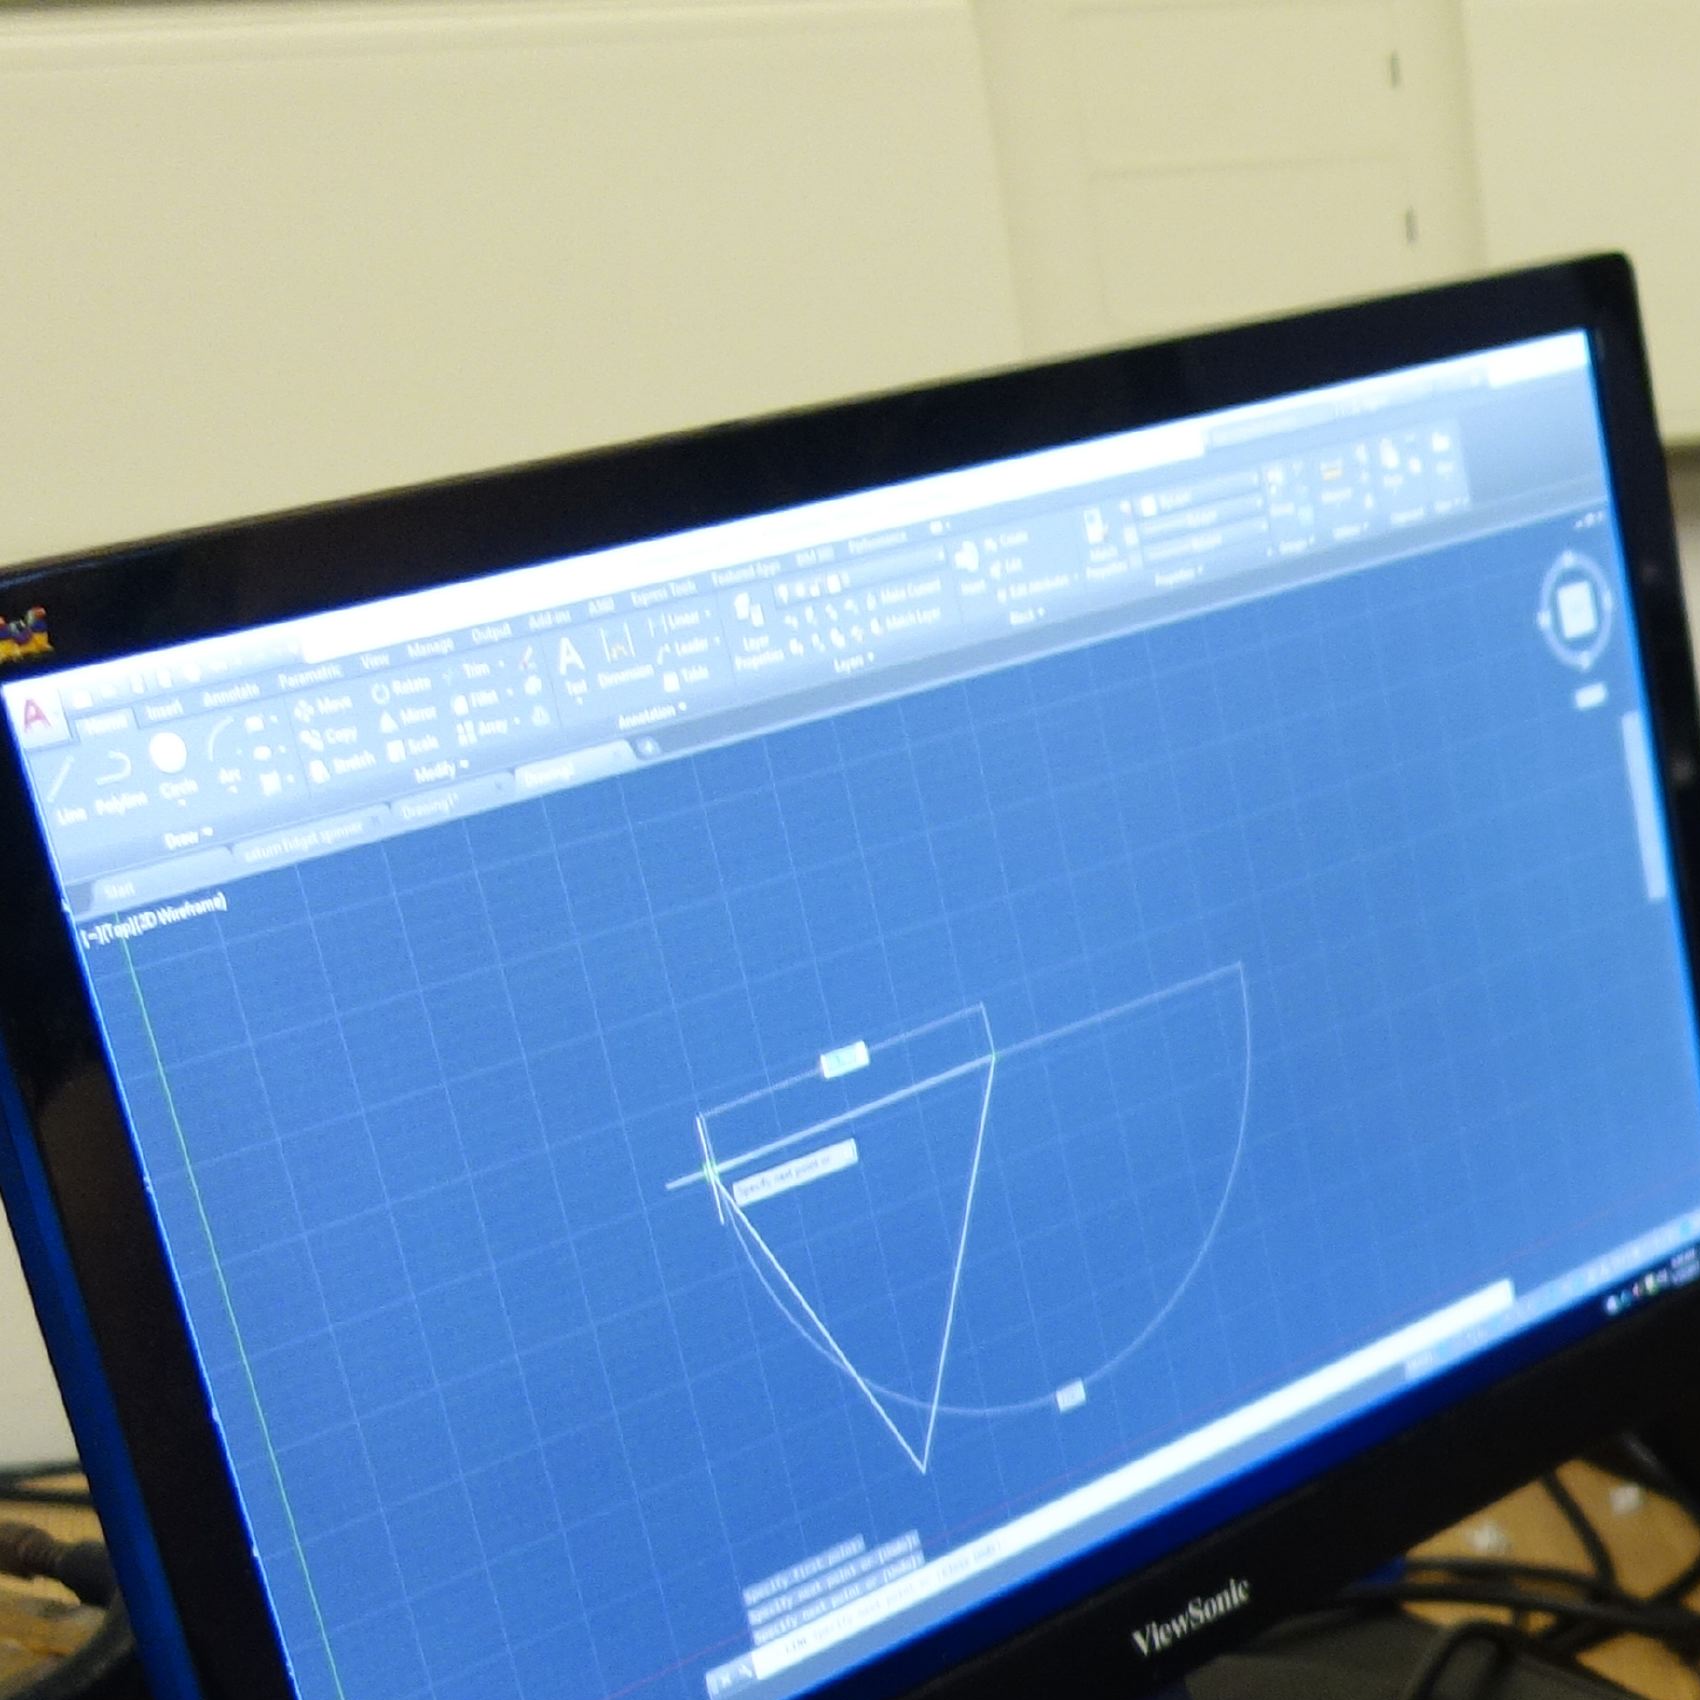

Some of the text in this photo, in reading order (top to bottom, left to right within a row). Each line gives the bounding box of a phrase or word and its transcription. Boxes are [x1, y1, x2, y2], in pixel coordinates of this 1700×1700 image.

[472, 623, 512, 643] Output
[407, 638, 454, 658] Manage
[360, 653, 390, 670] View
[463, 661, 491, 679] Trim
[279, 665, 342, 689] Parametric
[392, 675, 432, 696] Rotate
[203, 684, 260, 707] Annotate
[317, 694, 352, 714] Move
[147, 700, 183, 720] Insert
[401, 705, 438, 726] Mirror
[619, 703, 676, 729] Annotation
[324, 725, 357, 745] Copy
[477, 718, 508, 737] Array
[408, 734, 439, 754] Scale
[219, 768, 241, 785] Arc
[414, 760, 456, 784] Modify
[159, 778, 199, 799] Circle
[164, 831, 199, 849] Draw
[156, 890, 228, 926] Wireframe]
[1132, 1578, 1249, 1656] ViewSonic
